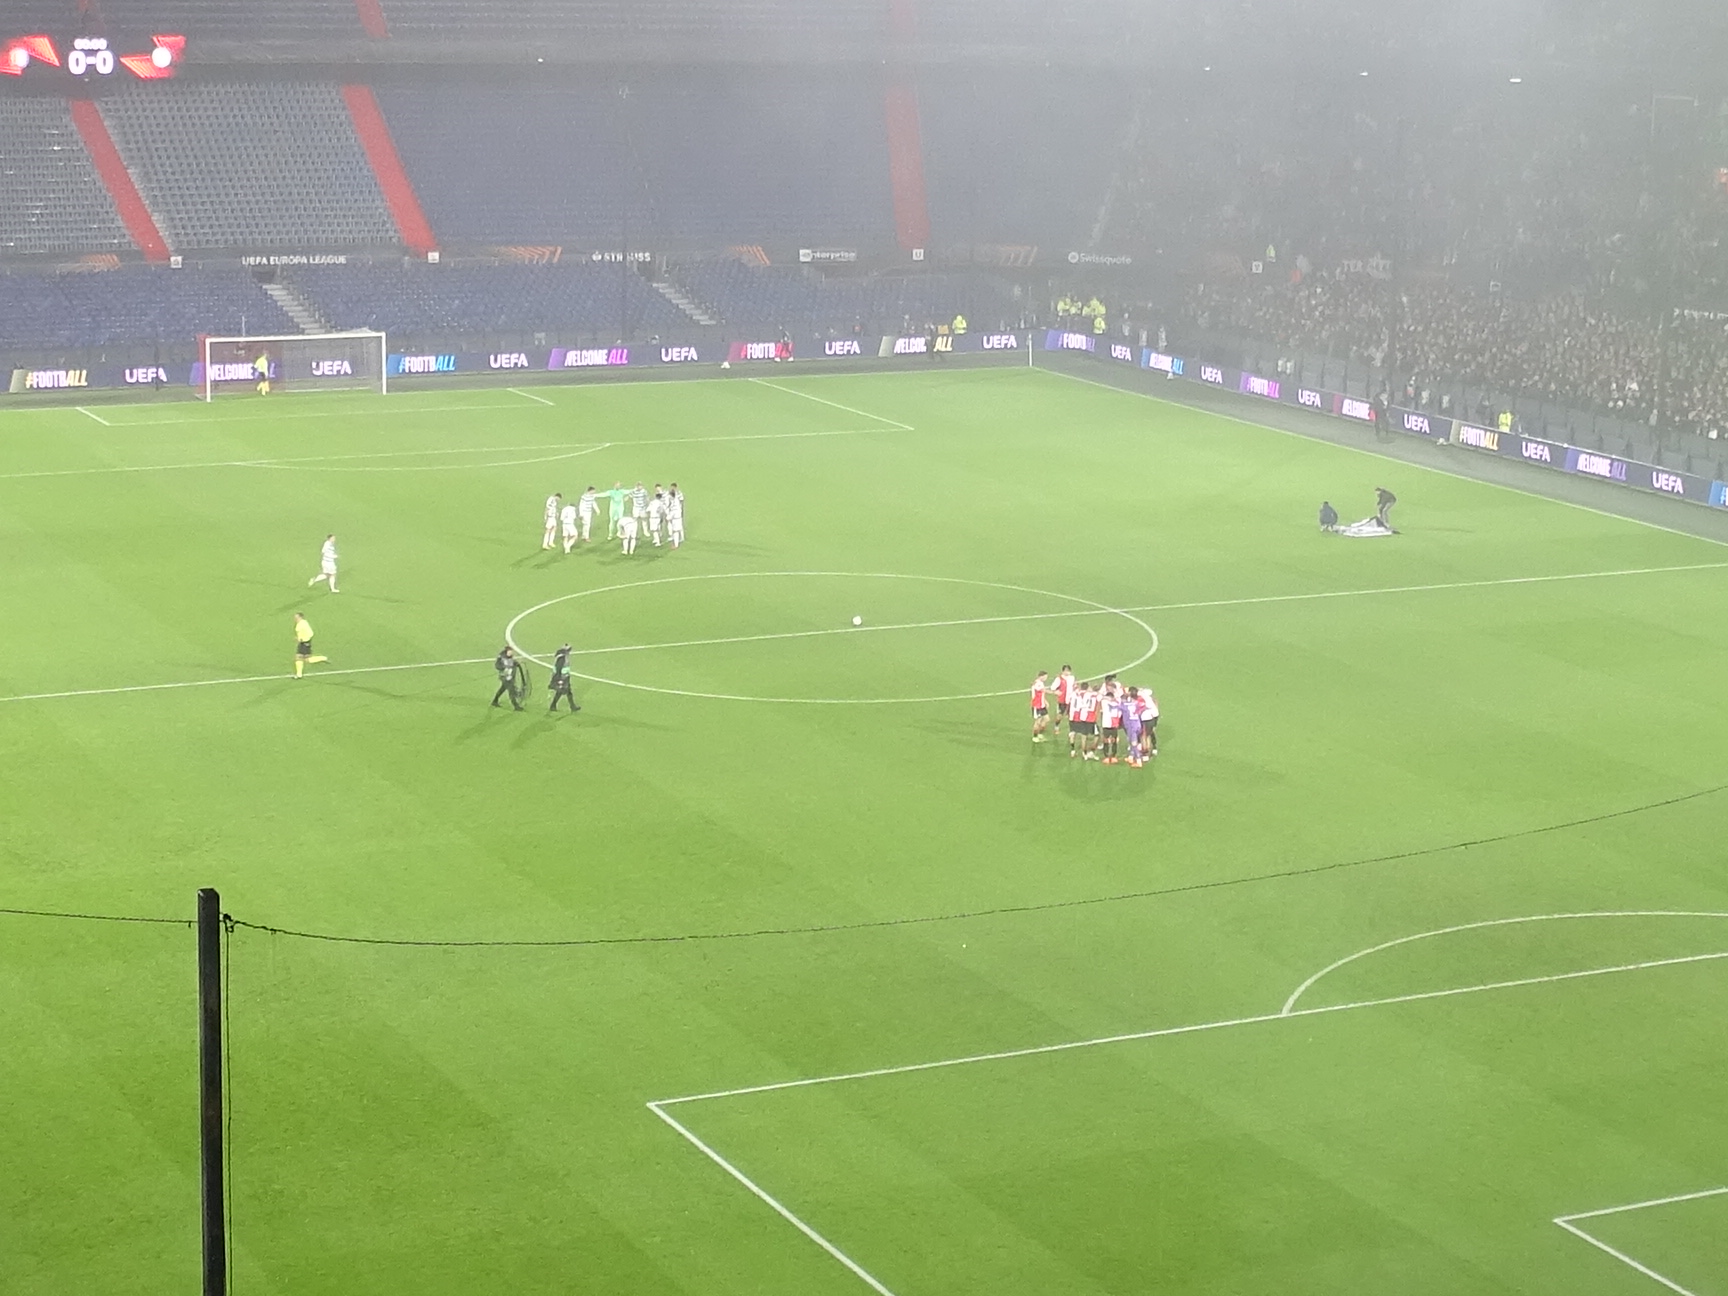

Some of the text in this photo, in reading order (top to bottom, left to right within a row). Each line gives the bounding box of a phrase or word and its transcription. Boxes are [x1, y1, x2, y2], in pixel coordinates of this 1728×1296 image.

[68, 50, 114, 75] 0-0
[824, 340, 861, 355] UEFA
[933, 336, 953, 352] ALL
[983, 334, 1017, 349] UEFA
[489, 352, 529, 369] UEFA
[660, 346, 698, 362] UEFA
[1110, 344, 1132, 362] UEFA
[312, 359, 352, 376] UEFA
[398, 354, 456, 373] #FOOTBALL
[25, 369, 88, 389] #FOOTBALL
[124, 367, 168, 383] UEFA
[1201, 365, 1223, 384] UEFA
[1298, 389, 1321, 408] UEFA
[1403, 413, 1430, 434] UEFA
[1522, 441, 1551, 463] UEFA
[1652, 470, 1684, 494] UEFA
